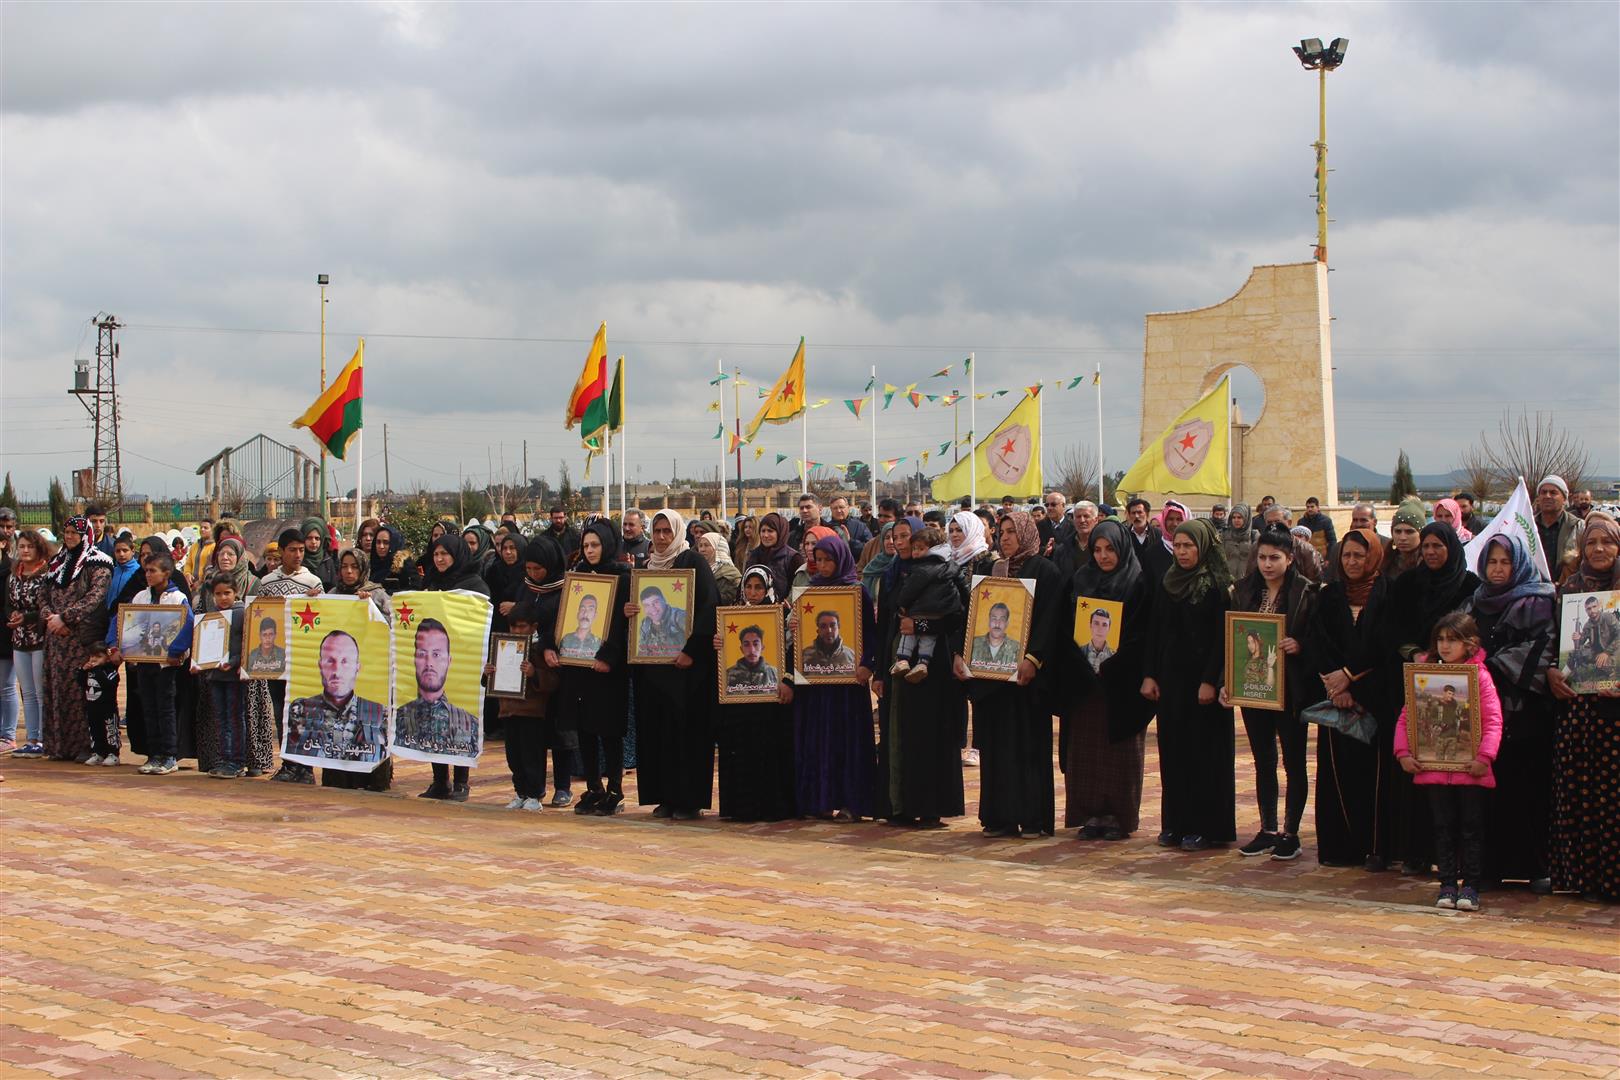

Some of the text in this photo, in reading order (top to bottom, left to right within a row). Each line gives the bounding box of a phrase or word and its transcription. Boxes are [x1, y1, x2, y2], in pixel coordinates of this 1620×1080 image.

[303, 738, 376, 756] الشهيد حاج خان
[446, 742, 473, 754] الشهيد
